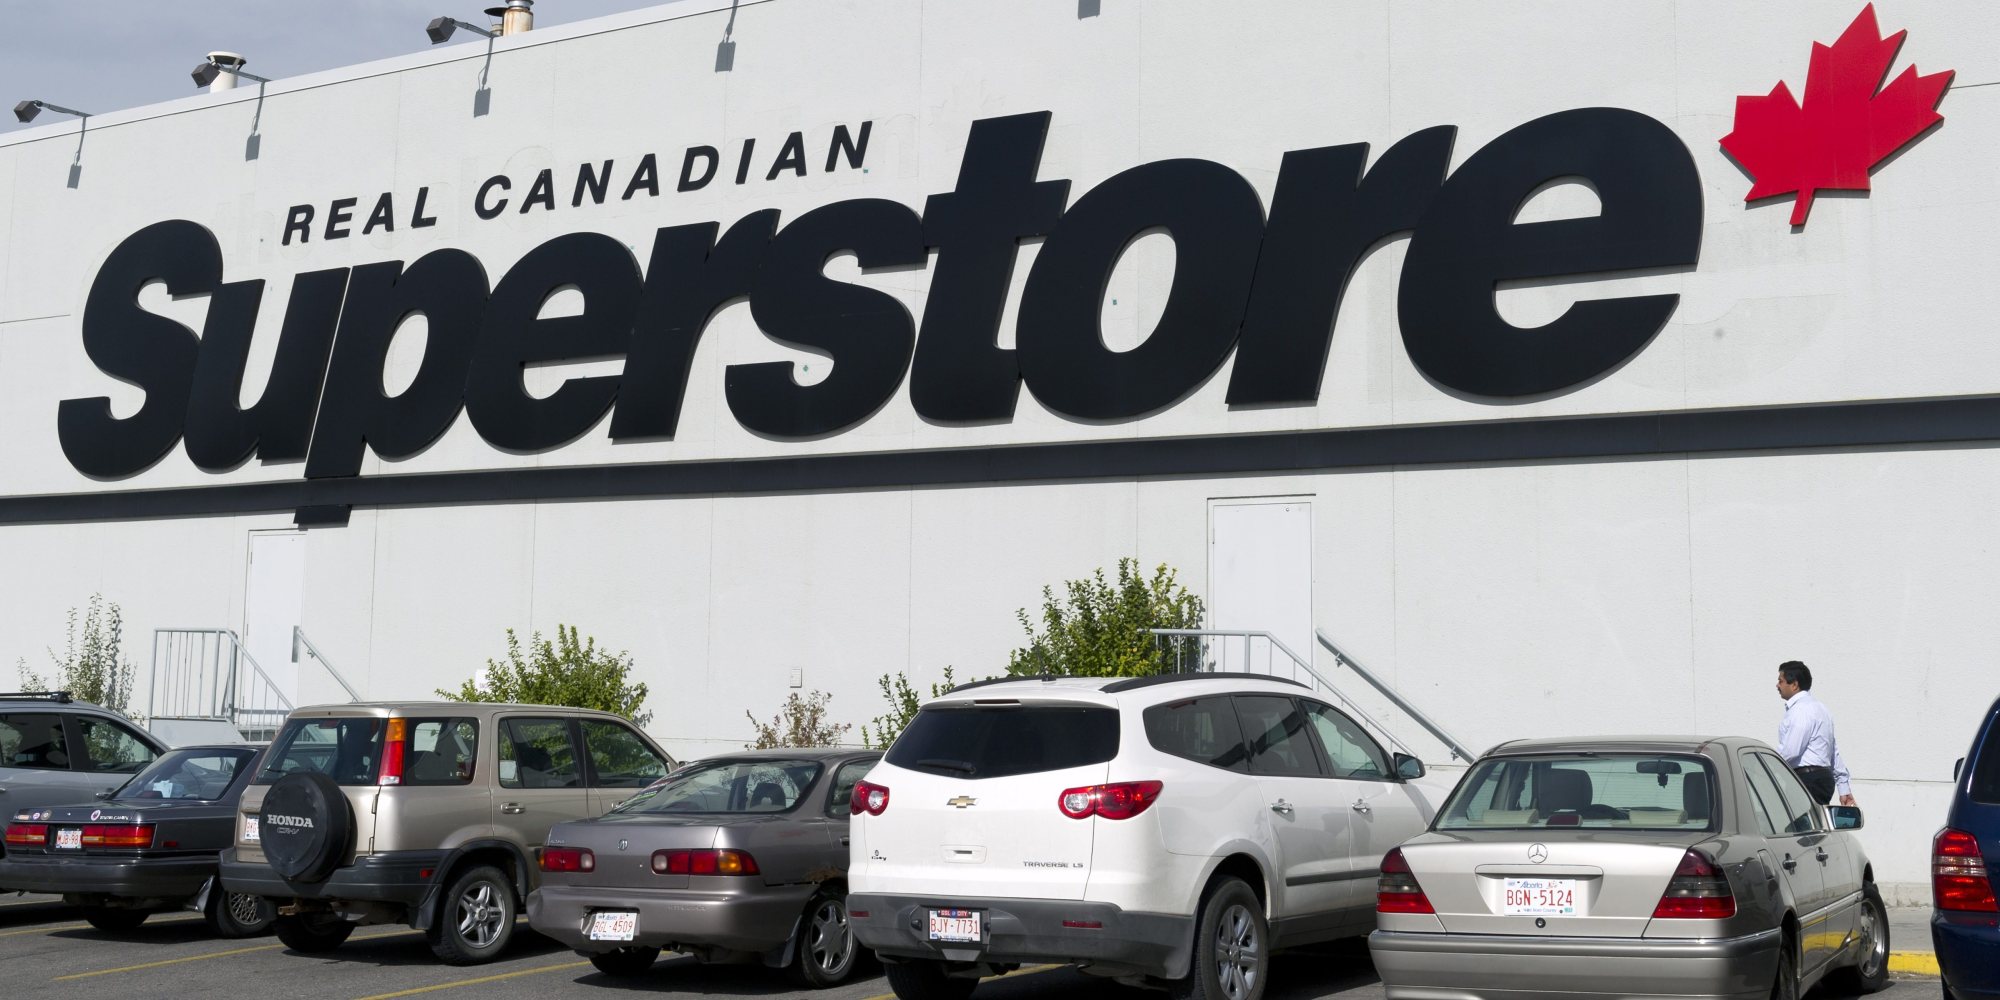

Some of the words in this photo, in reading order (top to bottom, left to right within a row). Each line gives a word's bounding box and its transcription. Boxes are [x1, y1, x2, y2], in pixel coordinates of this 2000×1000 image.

[281, 187, 437, 246] REAL
[475, 120, 873, 220] CANADIAN
[58, 107, 1702, 526] Superstore
[267, 814, 314, 828] HONDA
[1520, 880, 1543, 889] Alberta
[1506, 889, 1573, 906] BGN-5124
[592, 920, 634, 933] BGL-4509
[930, 918, 979, 935] BJY-7731
